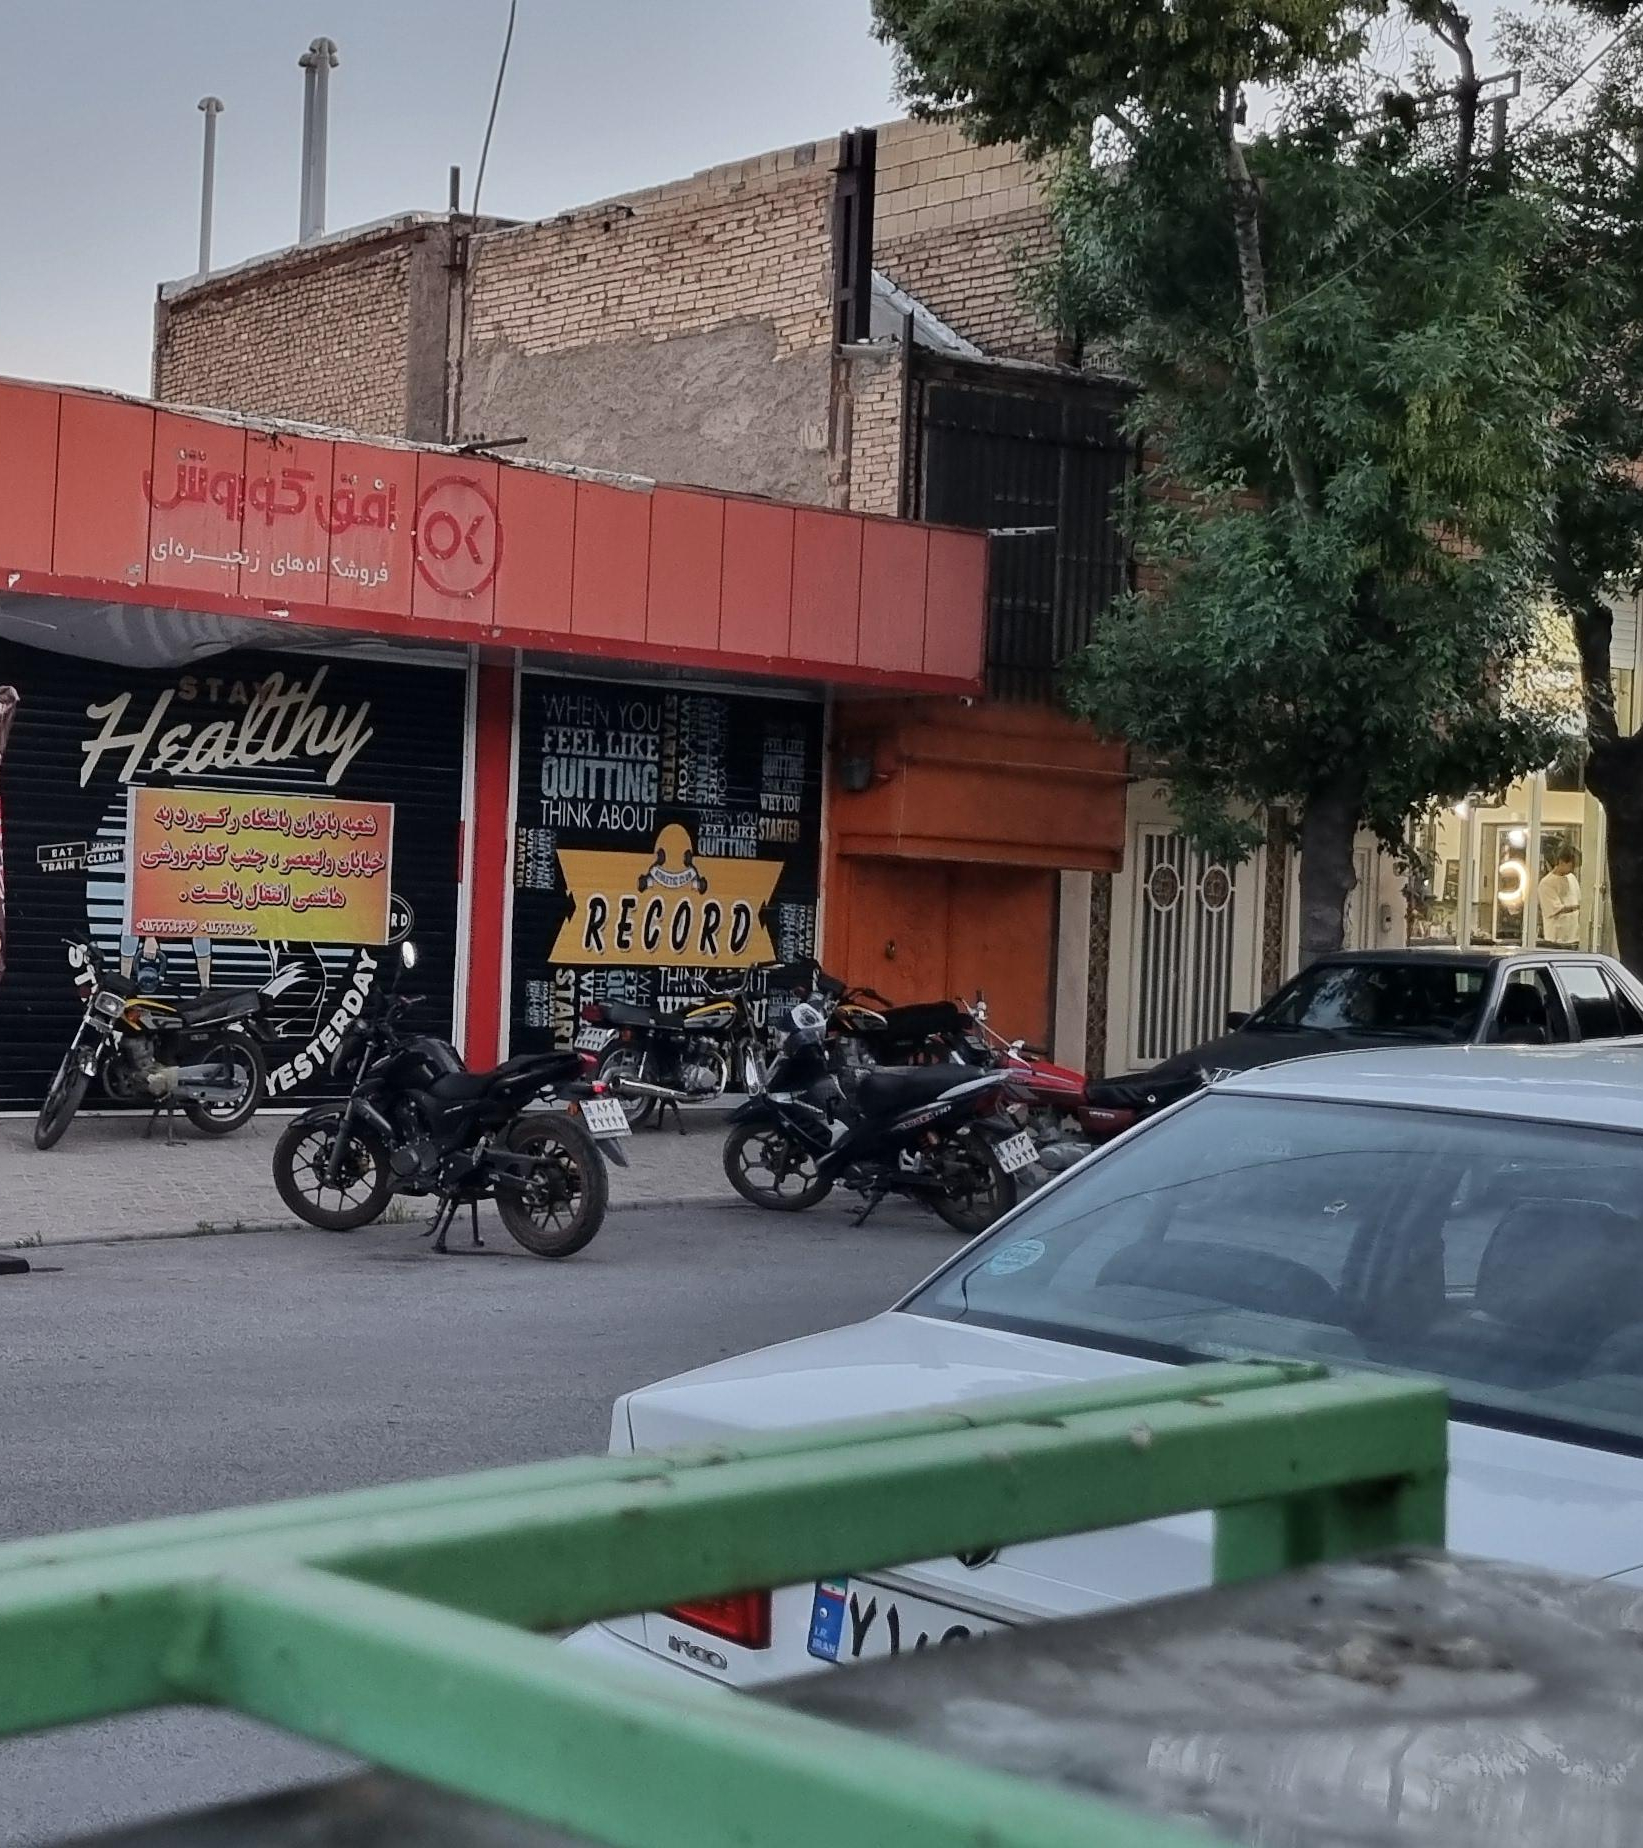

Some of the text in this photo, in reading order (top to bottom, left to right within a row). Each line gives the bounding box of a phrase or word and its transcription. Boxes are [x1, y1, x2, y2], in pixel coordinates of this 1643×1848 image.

[80, 664, 374, 787] Healthy
[544, 696, 661, 731] WHEN YOU
[542, 726, 659, 759] FEEL LIKE
[662, 694, 679, 803] STARTED
[541, 756, 658, 802] QUITTING
[677, 753, 688, 802] YOU
[540, 801, 657, 832] THINK ABOUT
[760, 793, 801, 814] WHY YOU
[154, 804, 378, 840] شعبه بانوان باشگاه رکورد به
[698, 824, 757, 841] FEEL LIKE
[738, 811, 758, 828] YOU
[759, 817, 800, 844] STARTED
[51, 846, 74, 859] EAT
[87, 851, 120, 865] CLEAN
[141, 841, 228, 873] کتابفروشی
[229, 847, 267, 873] جنب
[282, 848, 335, 877] ولیعصر
[515, 827, 526, 888] STARTED
[698, 838, 757, 859] QUITTING
[41, 861, 76, 873] TRAIN
[337, 849, 385, 877] خیابان
[525, 862, 533, 888] YOU
[191, 880, 242, 906] یافت
[245, 882, 290, 910] انتقال
[292, 886, 346, 911] هاشمی
[583, 893, 752, 956] RECORD
[264, 946, 379, 1098] YESTERDAY
[811, 1638, 836, 1655] IRAN
